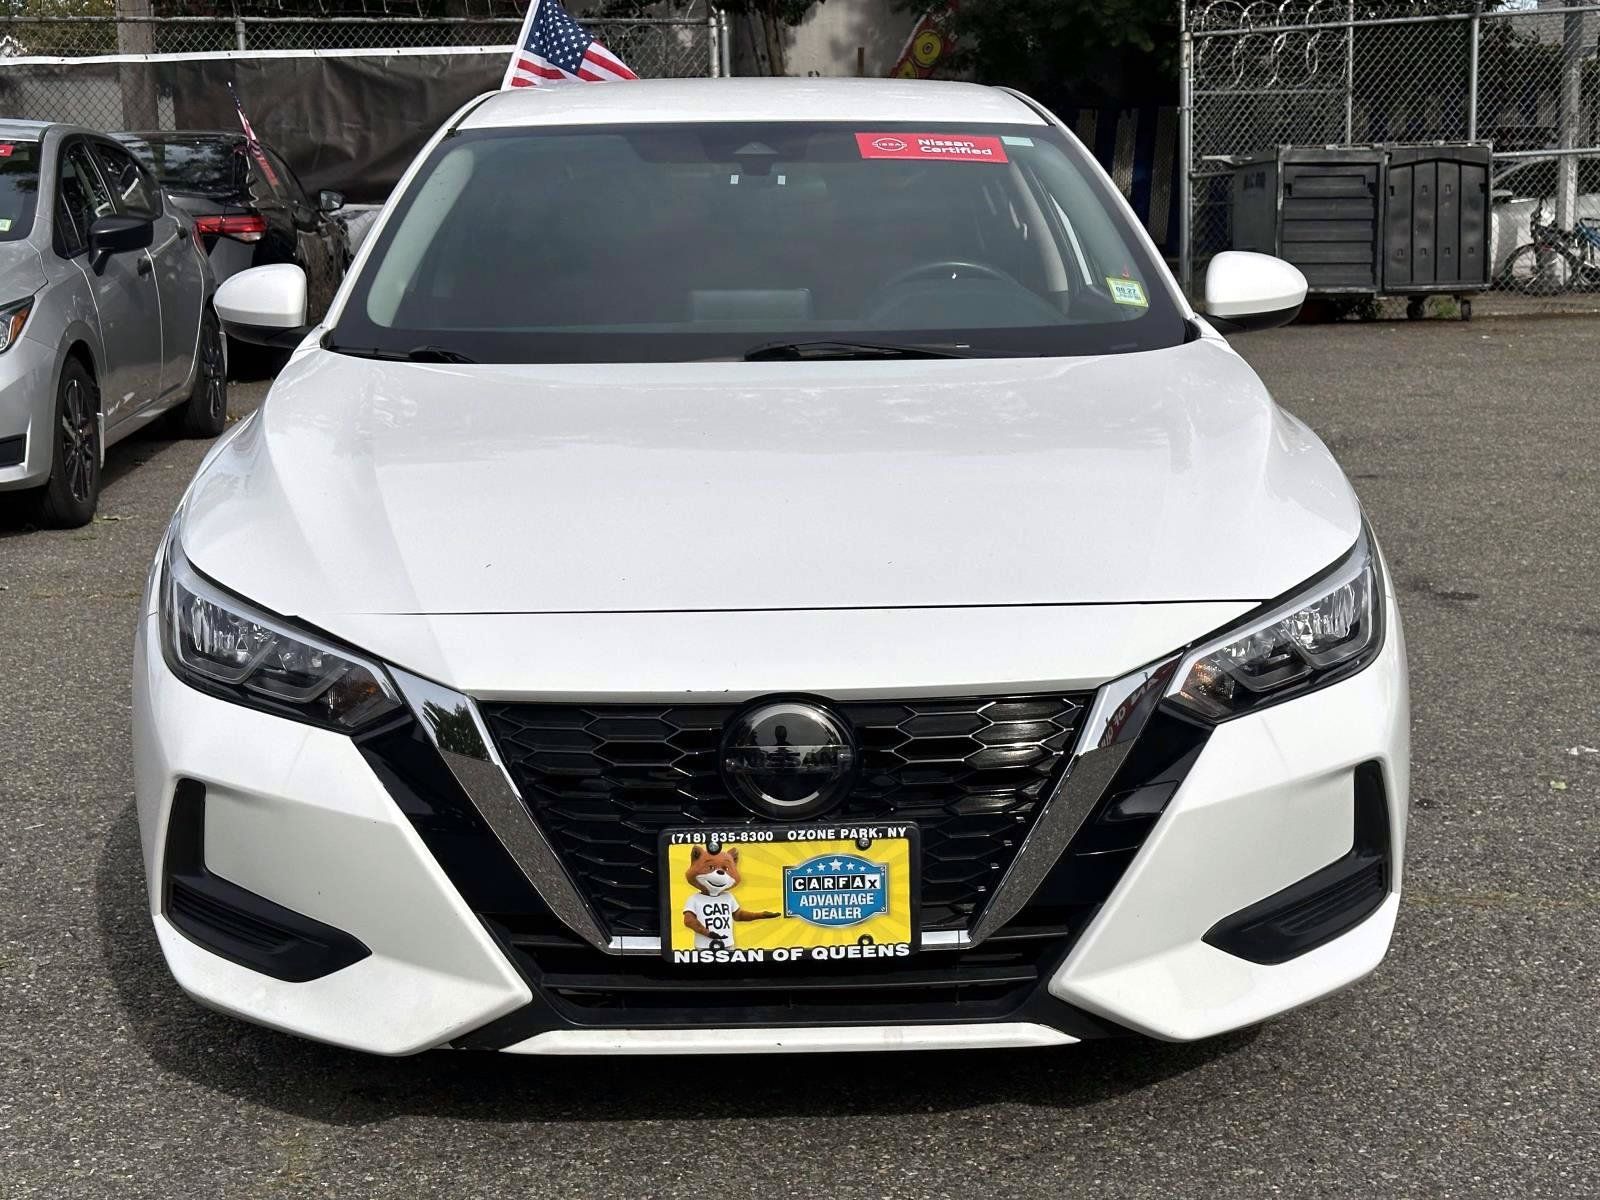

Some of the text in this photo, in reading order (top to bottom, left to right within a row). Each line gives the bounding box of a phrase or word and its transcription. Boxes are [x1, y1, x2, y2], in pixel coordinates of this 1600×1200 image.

[917, 138, 975, 148] Nissan
[920, 145, 993, 156] Certified
[671, 827, 907, 844] (718) 835-8300 OZONE PARK, NY
[800, 893, 874, 907] ADVANTAGE
[703, 903, 730, 916] CAR
[813, 906, 862, 920] DEALER
[705, 917, 731, 930] FOX
[674, 944, 910, 964] NISSAN OF QUEENS
